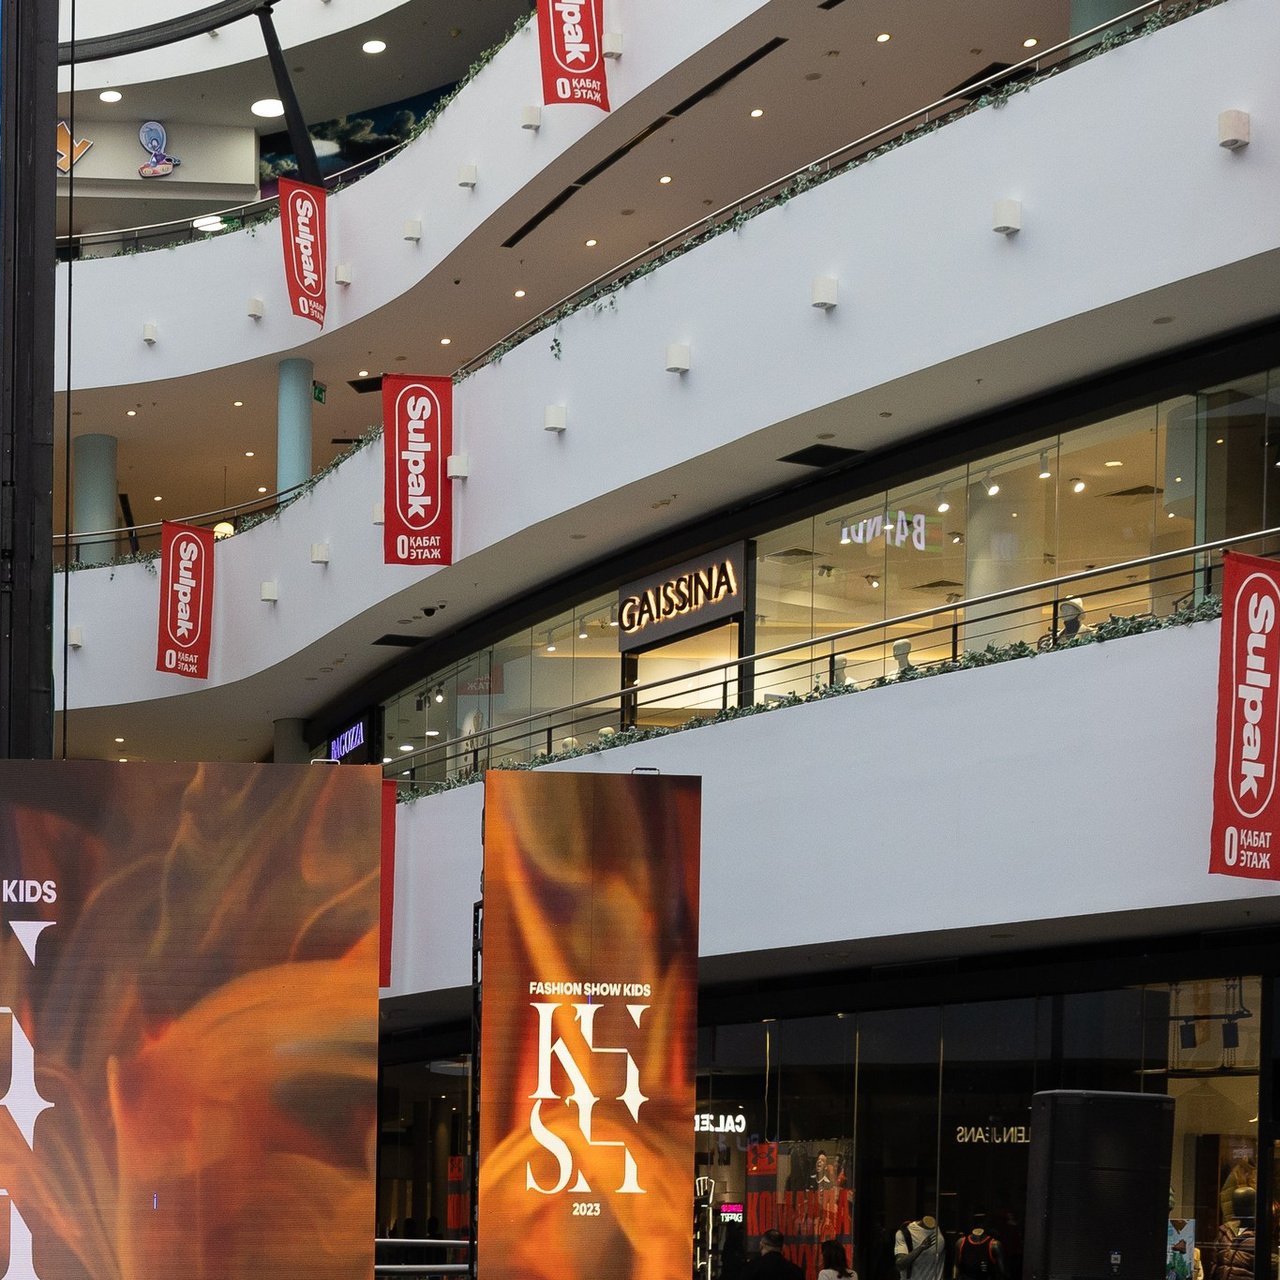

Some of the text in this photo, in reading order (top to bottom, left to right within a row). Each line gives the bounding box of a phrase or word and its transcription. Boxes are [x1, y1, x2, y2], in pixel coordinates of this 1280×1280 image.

[556, 77, 601, 98] 0 ҚАБАТ
[574, 89, 601, 103] ЭТАЖ
[295, 198, 318, 289] Sulpak
[298, 296, 309, 315] 0
[401, 395, 431, 519] Sulpak
[396, 534, 441, 559] 0 ҚАБАТ
[409, 548, 441, 560] ЭТАЖ
[173, 541, 198, 639] Sulpak
[618, 561, 736, 632] GAISSINA
[165, 649, 177, 669] 0
[1238, 592, 1275, 799] Sulpak
[1224, 826, 1272, 866] 0 ҚАБАТ
[1239, 849, 1271, 870] ЭТАЖ
[2, 880, 57, 904] KIDS
[529, 981, 651, 997] FASHION SHOW KIDS
[572, 1203, 601, 1216] 2023
